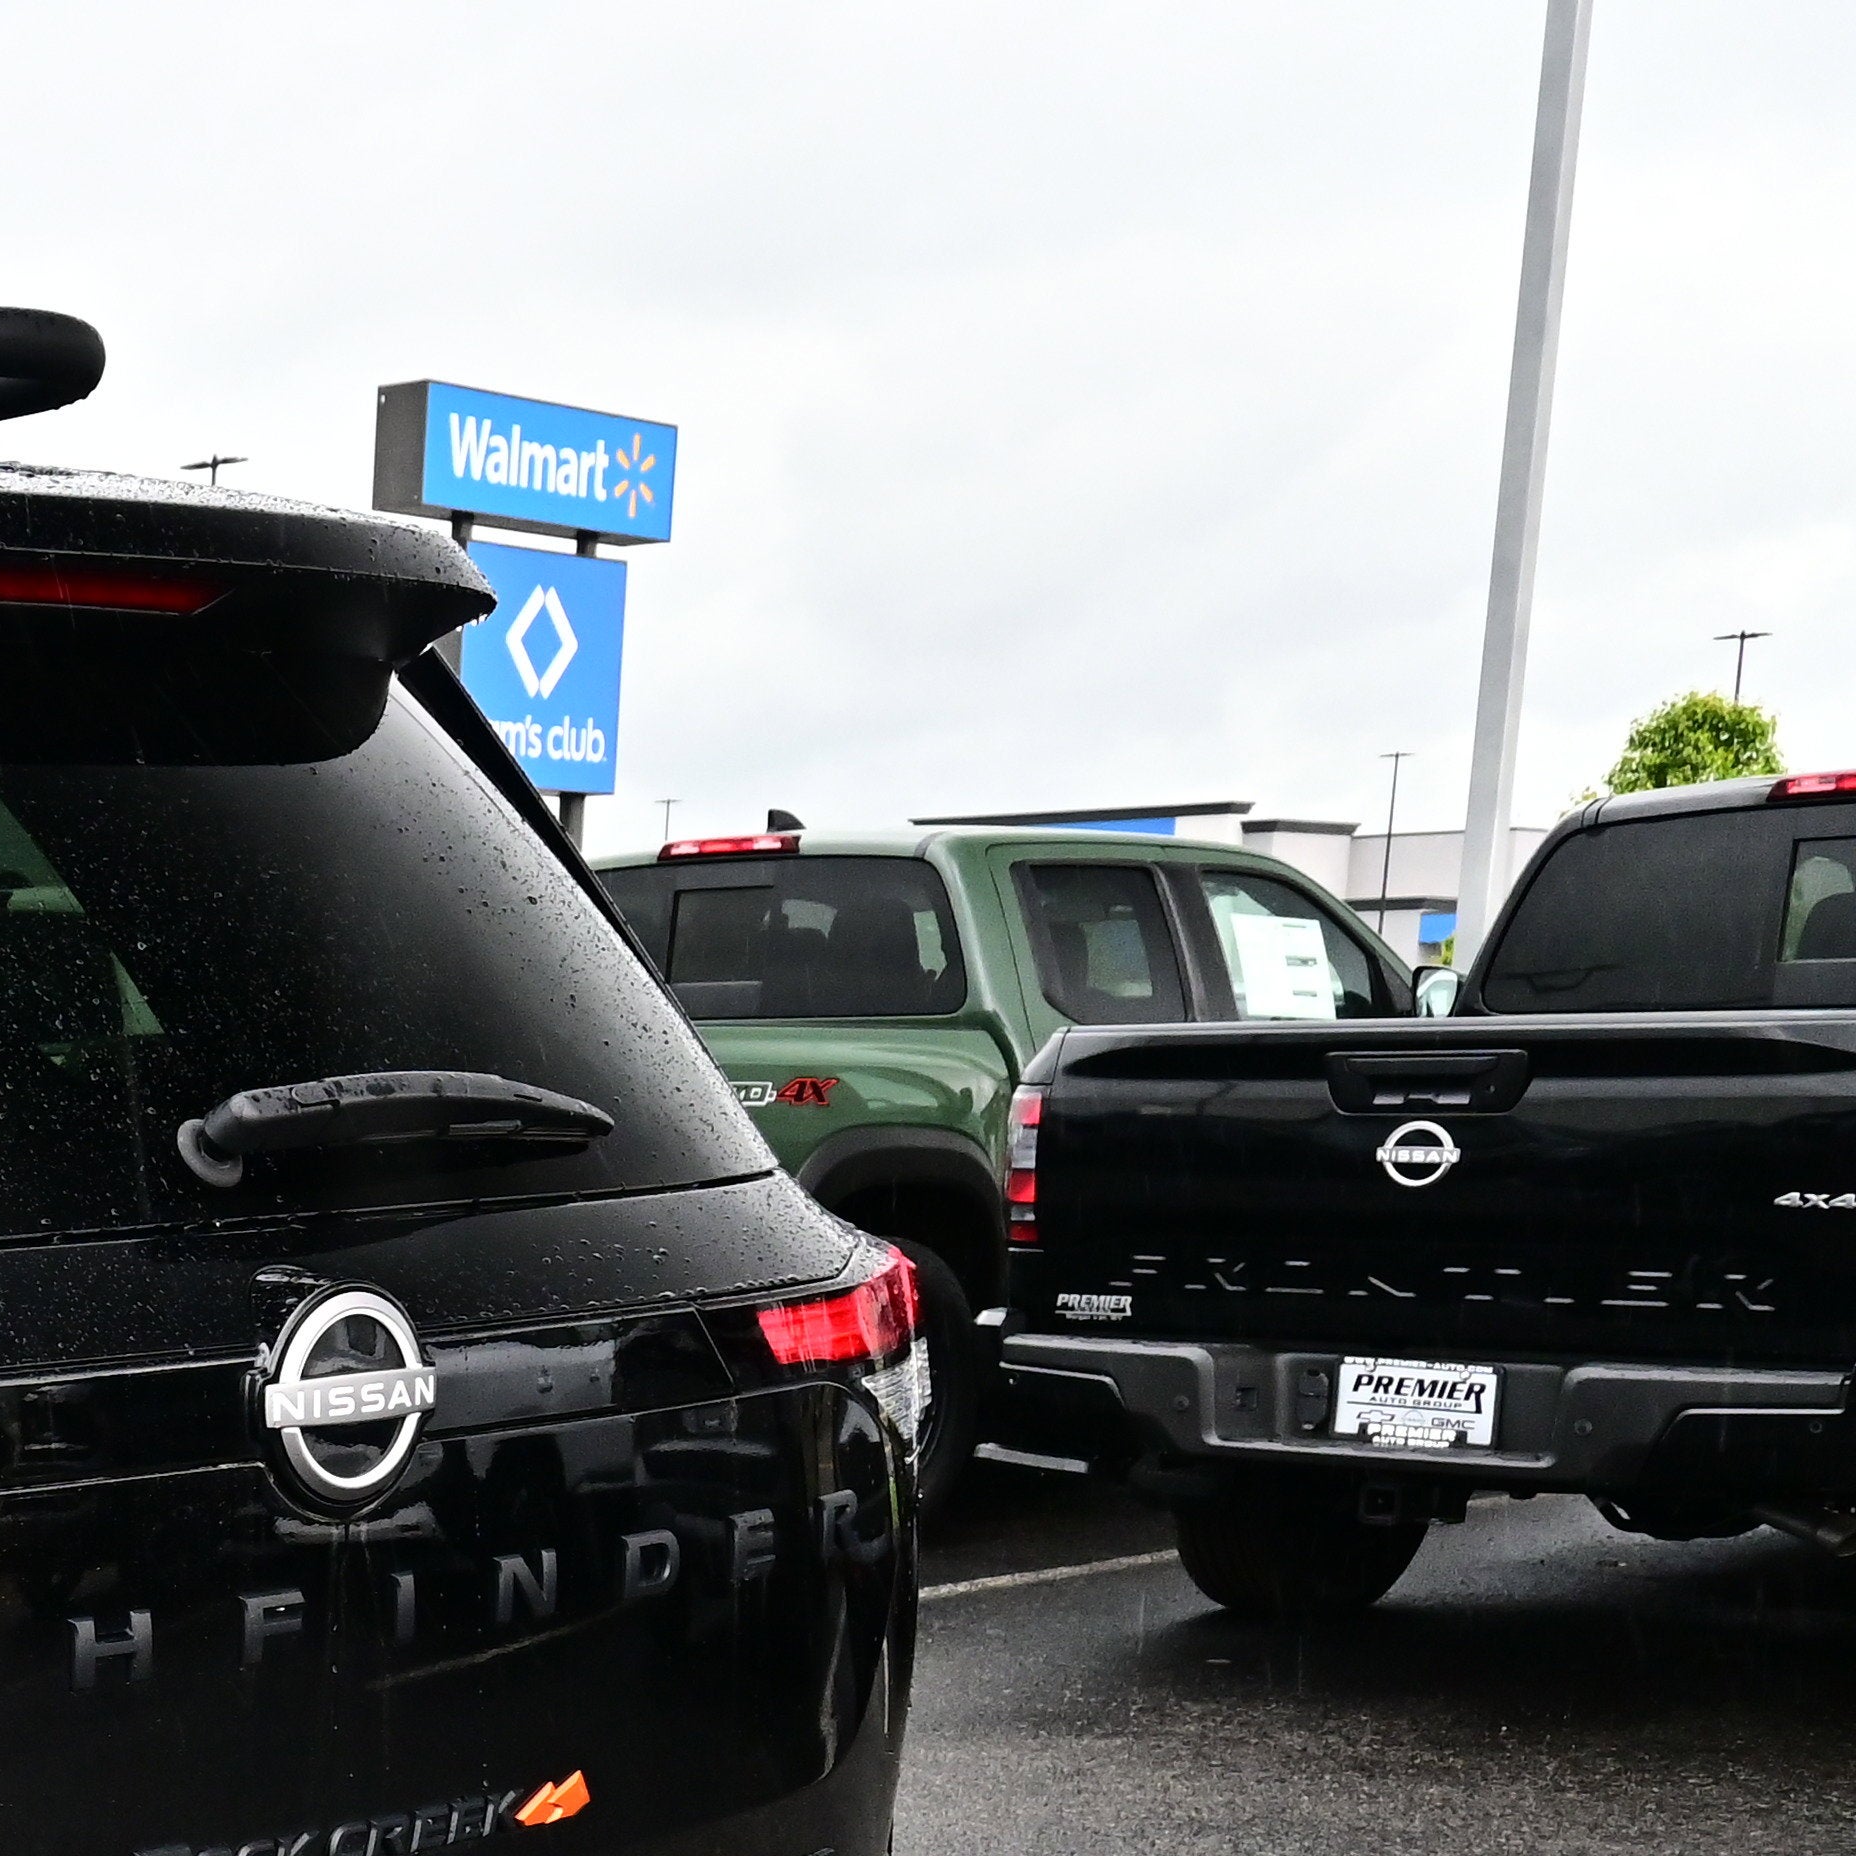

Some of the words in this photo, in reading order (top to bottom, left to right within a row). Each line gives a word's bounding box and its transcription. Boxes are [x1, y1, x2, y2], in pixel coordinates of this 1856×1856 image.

[449, 411, 609, 501] Walmart
[489, 714, 542, 758] m's
[547, 715, 605, 763] club
[1377, 1149, 1459, 1163] NISSAN
[1055, 1293, 1132, 1315] PREMIER
[273, 1375, 435, 1421] NISSAN
[1352, 1373, 1487, 1414] PREMIER
[1369, 1396, 1407, 1405] AUTO
[1412, 1400, 1463, 1409] GROUP
[1367, 1422, 1457, 1443] PREMIER
[1431, 1417, 1475, 1430] GMC
